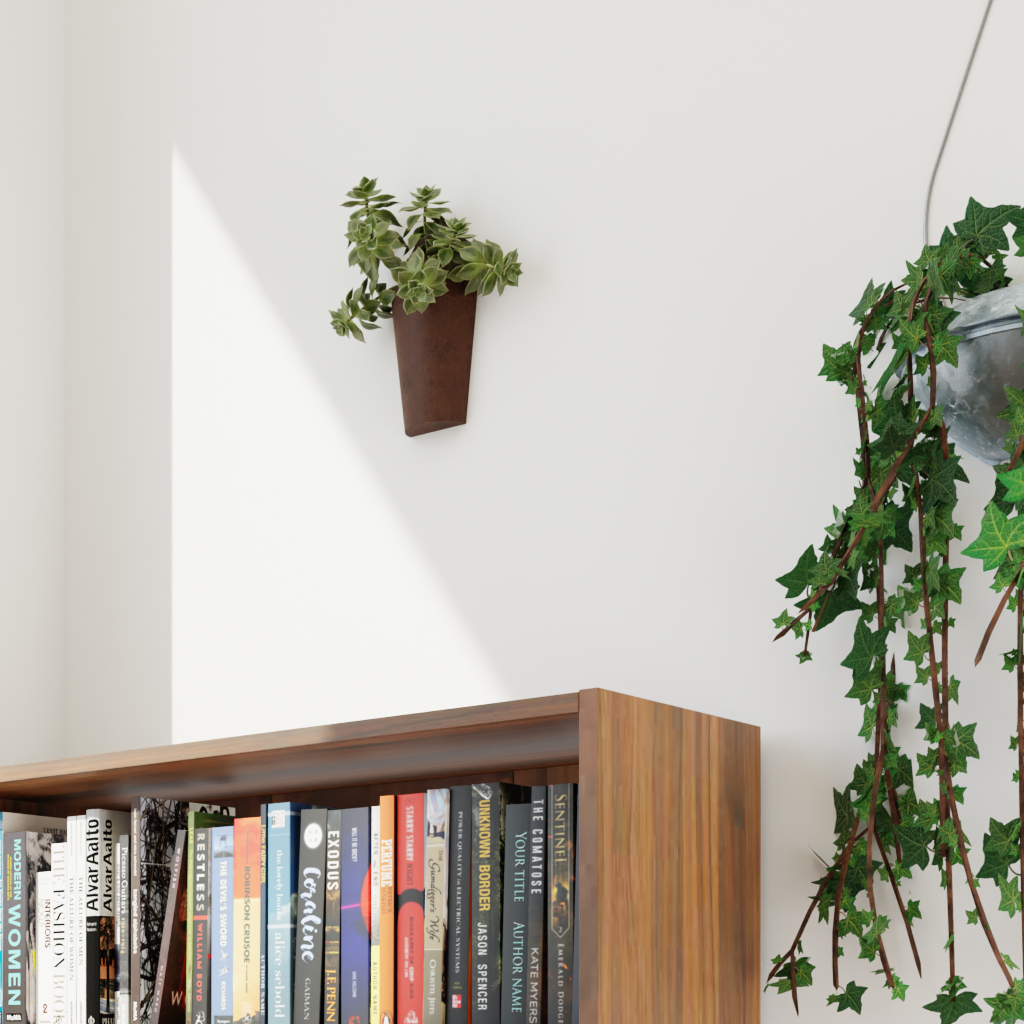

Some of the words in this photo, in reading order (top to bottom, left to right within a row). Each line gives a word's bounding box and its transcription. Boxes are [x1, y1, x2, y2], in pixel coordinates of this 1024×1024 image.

[479, 800, 490, 858] UNKNOWN
[533, 799, 544, 821] THE
[554, 794, 567, 866] SENTINEL
[88, 819, 99, 865] Aalto
[103, 819, 112, 861] Aalto
[327, 830, 339, 890] EXODUS
[514, 831, 527, 867] YOUR
[531, 829, 543, 894] COMATOSE
[53, 846, 65, 883] THE
[172, 848, 181, 889] WOLFISH
[197, 833, 205, 911] RESTLESS
[274, 866, 282, 891] lovely
[381, 839, 392, 887] PERFUME
[88, 867, 99, 912] Alvar
[103, 863, 112, 912] Alvar
[479, 865, 490, 911] BORDER
[513, 870, 525, 902] TITLE
[53, 890, 65, 968] FASHION
[219, 913, 227, 947] SWORD
[300, 867, 321, 964] Coraline
[8, 904, 21, 1005] WOMEN
[274, 933, 285, 965] alice
[477, 922, 487, 956] JASON
[512, 922, 525, 974] AUTHOR
[530, 947, 539, 978] KATE
[557, 943, 565, 986] EMERALD
[53, 974, 66, 1024] BOOK
[274, 970, 285, 1018] sebold
[303, 978, 311, 1020] GAIMAN
[477, 964, 487, 1010] SPENCER
[511, 978, 522, 1013] NAME
[528, 982, 538, 1024] MYERS
